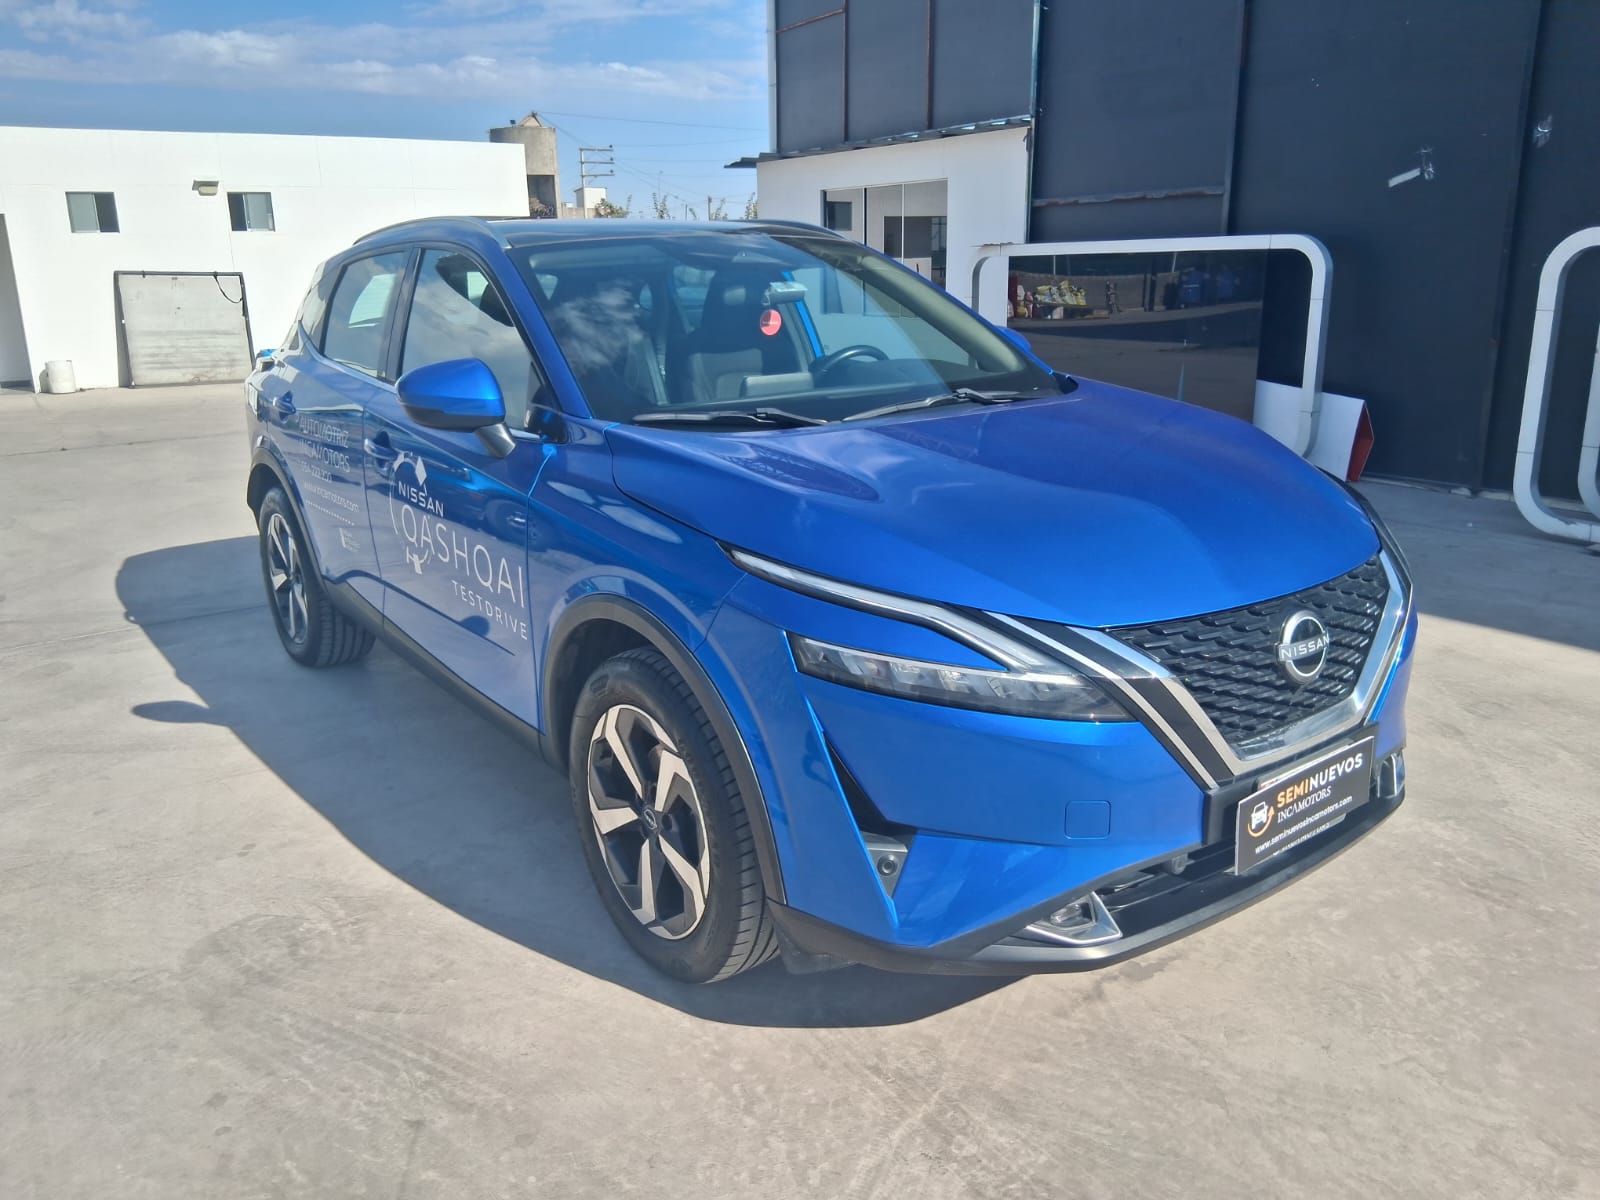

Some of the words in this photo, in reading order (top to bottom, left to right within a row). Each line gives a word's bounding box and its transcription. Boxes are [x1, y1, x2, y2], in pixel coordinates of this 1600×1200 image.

[398, 481, 444, 517] NISSAN
[401, 504, 525, 608] QASHQAI
[1281, 630, 1329, 659] NISSAN
[1277, 753, 1363, 808] SEMINUEVOS
[1277, 785, 1332, 824] INCAMOTORS
